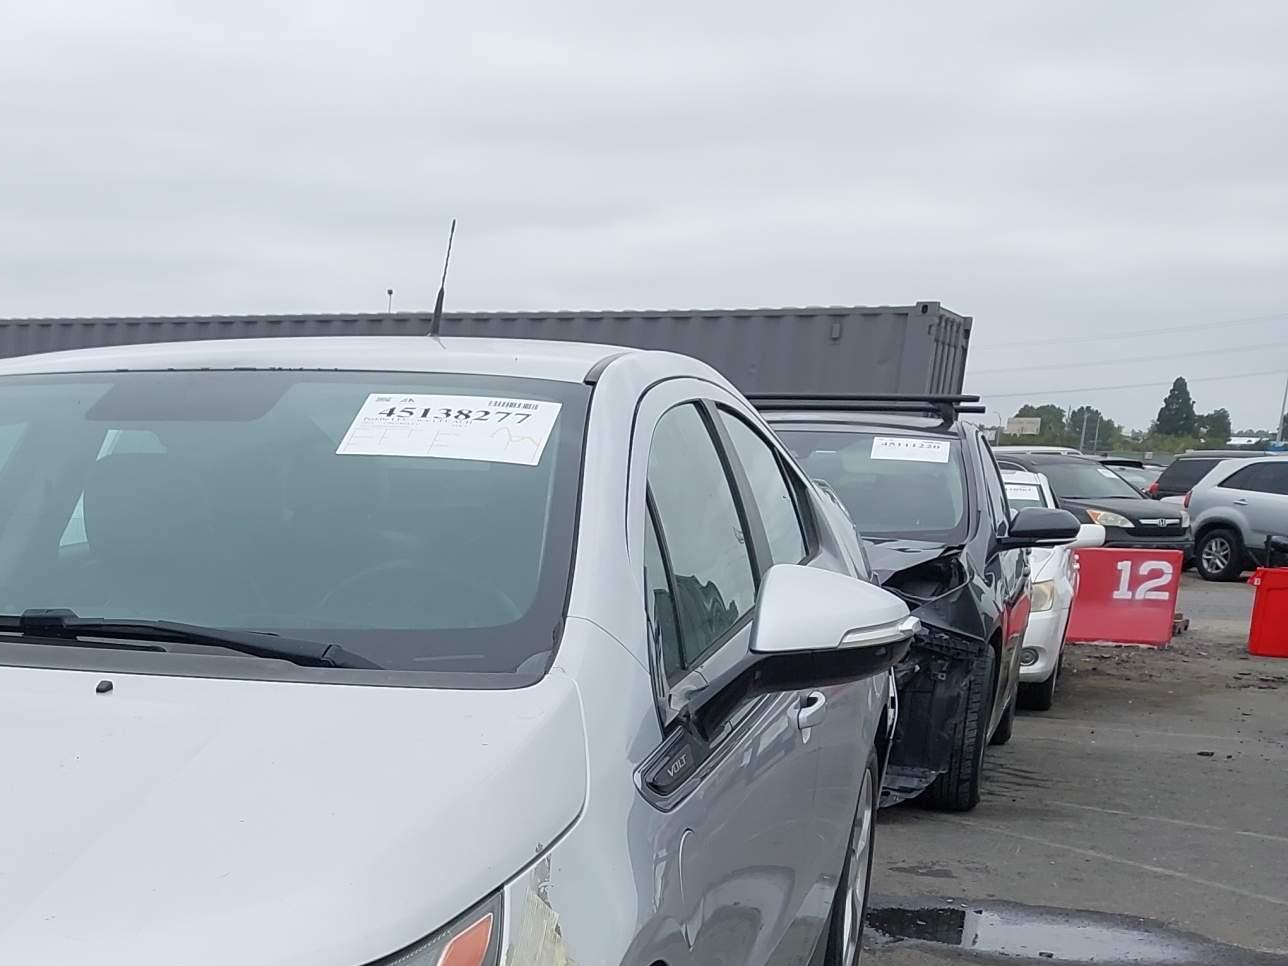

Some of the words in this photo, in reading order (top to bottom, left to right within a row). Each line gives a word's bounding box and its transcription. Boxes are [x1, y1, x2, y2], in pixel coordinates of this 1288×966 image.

[378, 407, 532, 424] 45138277
[1112, 560, 1174, 600] 12
[667, 754, 687, 777] VOLT
